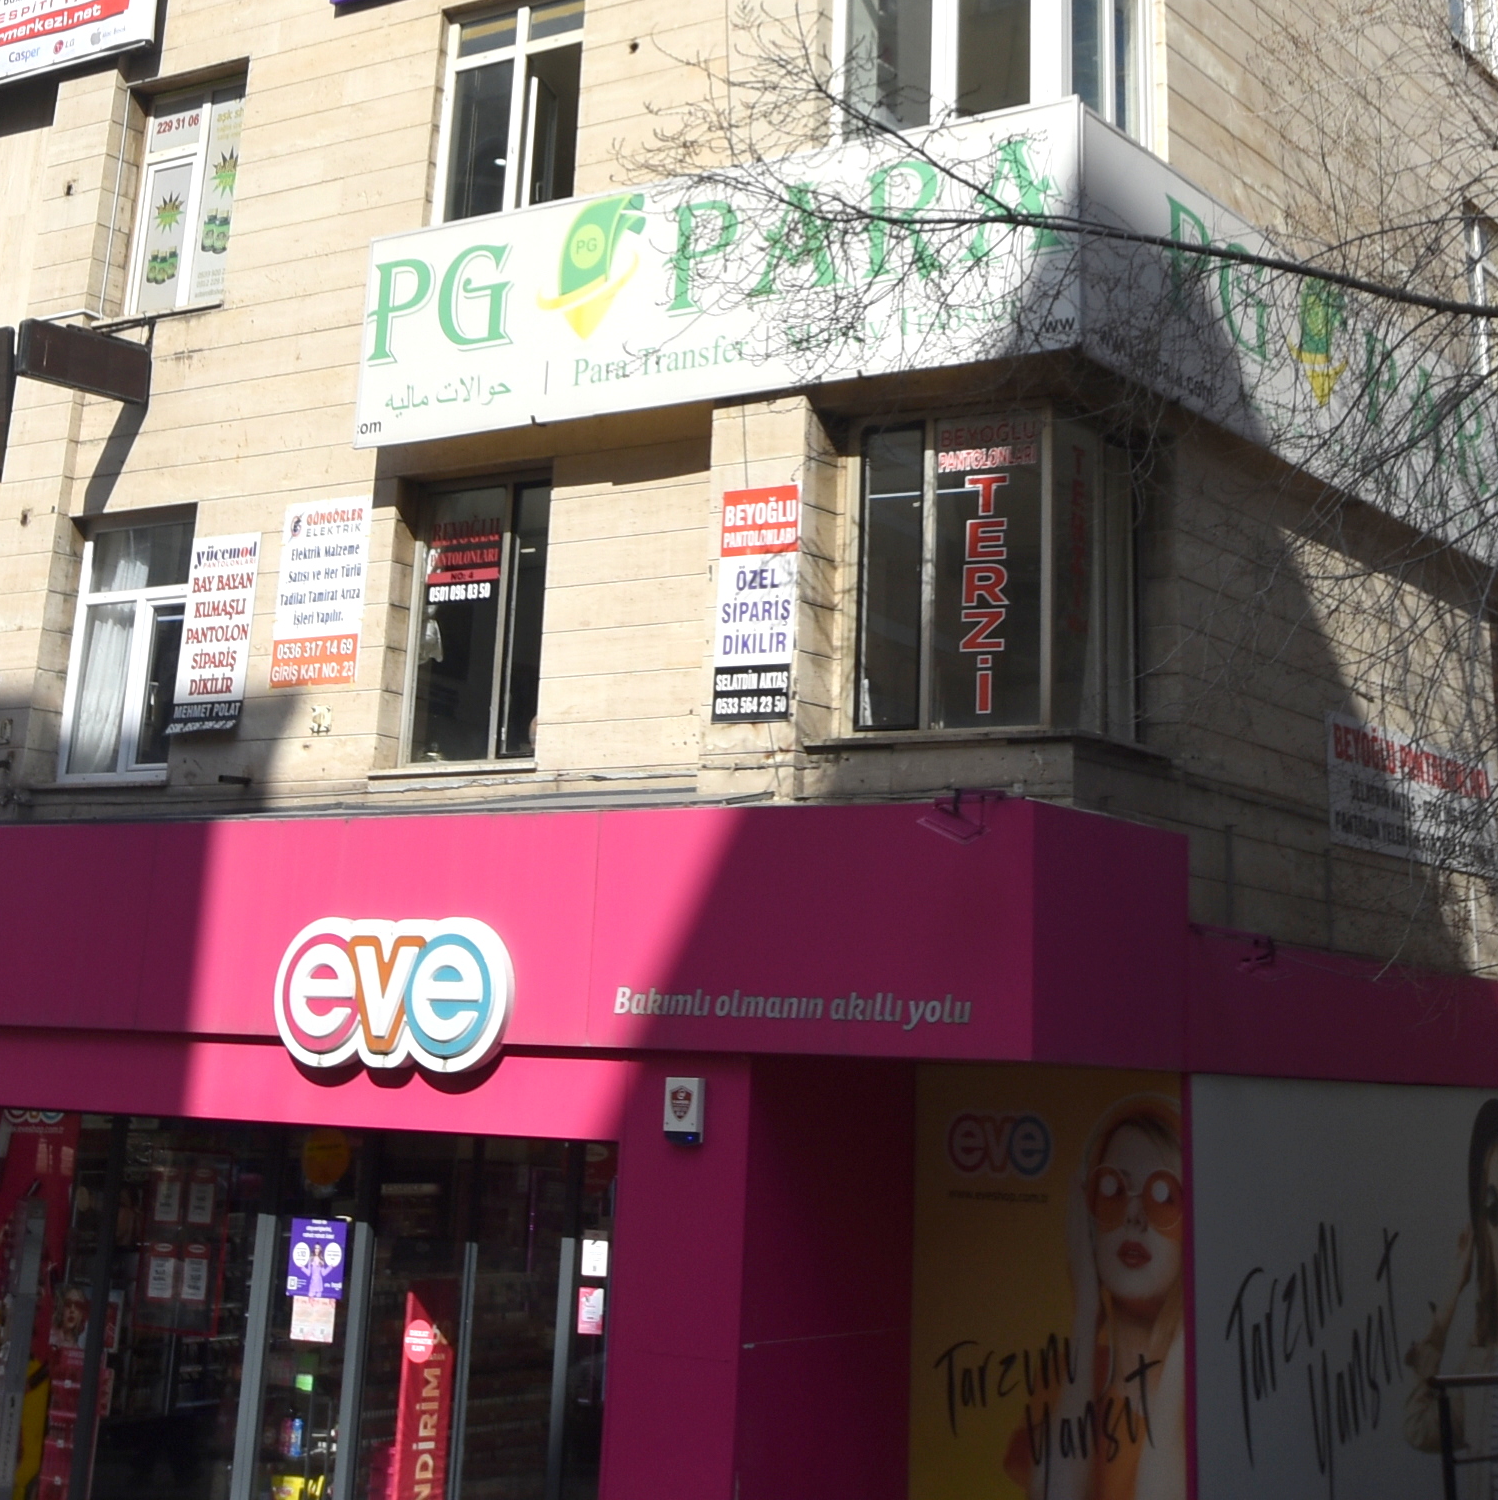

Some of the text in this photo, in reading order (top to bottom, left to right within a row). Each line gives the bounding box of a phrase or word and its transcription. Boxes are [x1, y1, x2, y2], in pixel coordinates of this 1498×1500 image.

[574, 235, 599, 254] PG
[366, 241, 514, 367] PG
[305, 508, 364, 527] GÜNGÖRLER
[723, 495, 798, 528] BEYOĞLU
[305, 522, 362, 538] ELEKTRİK
[722, 527, 798, 550] PANTOLONLARI
[291, 543, 360, 562] Elektrik Malzeme
[192, 572, 254, 594] BAY BAYAN
[312, 571, 322, 581] ve
[324, 567, 338, 579] Her
[341, 563, 362, 577] Türlü
[735, 565, 780, 592] ÖZEL
[280, 587, 361, 607] Tadilat Tamirat Arıza
[959, 472, 1010, 715] TERZİ
[194, 598, 246, 620] KUMAŞLI
[720, 598, 792, 627] SİPARİŞ
[185, 623, 249, 645] PANTOLON
[721, 630, 788, 656] DİKİLİR
[191, 647, 237, 672] SİPARİŞ
[188, 672, 234, 696] DİKİLİR
[272, 661, 354, 684] GİRİŞ KAT NO: 23
[760, 669, 789, 694] AKTAŞ
[174, 702, 241, 719] MEHMET POLAT
[284, 932, 493, 1057] eve
[612, 982, 973, 1028] Bakımlı olmanın akıllı yolu
[945, 1111, 1054, 1180] eve
